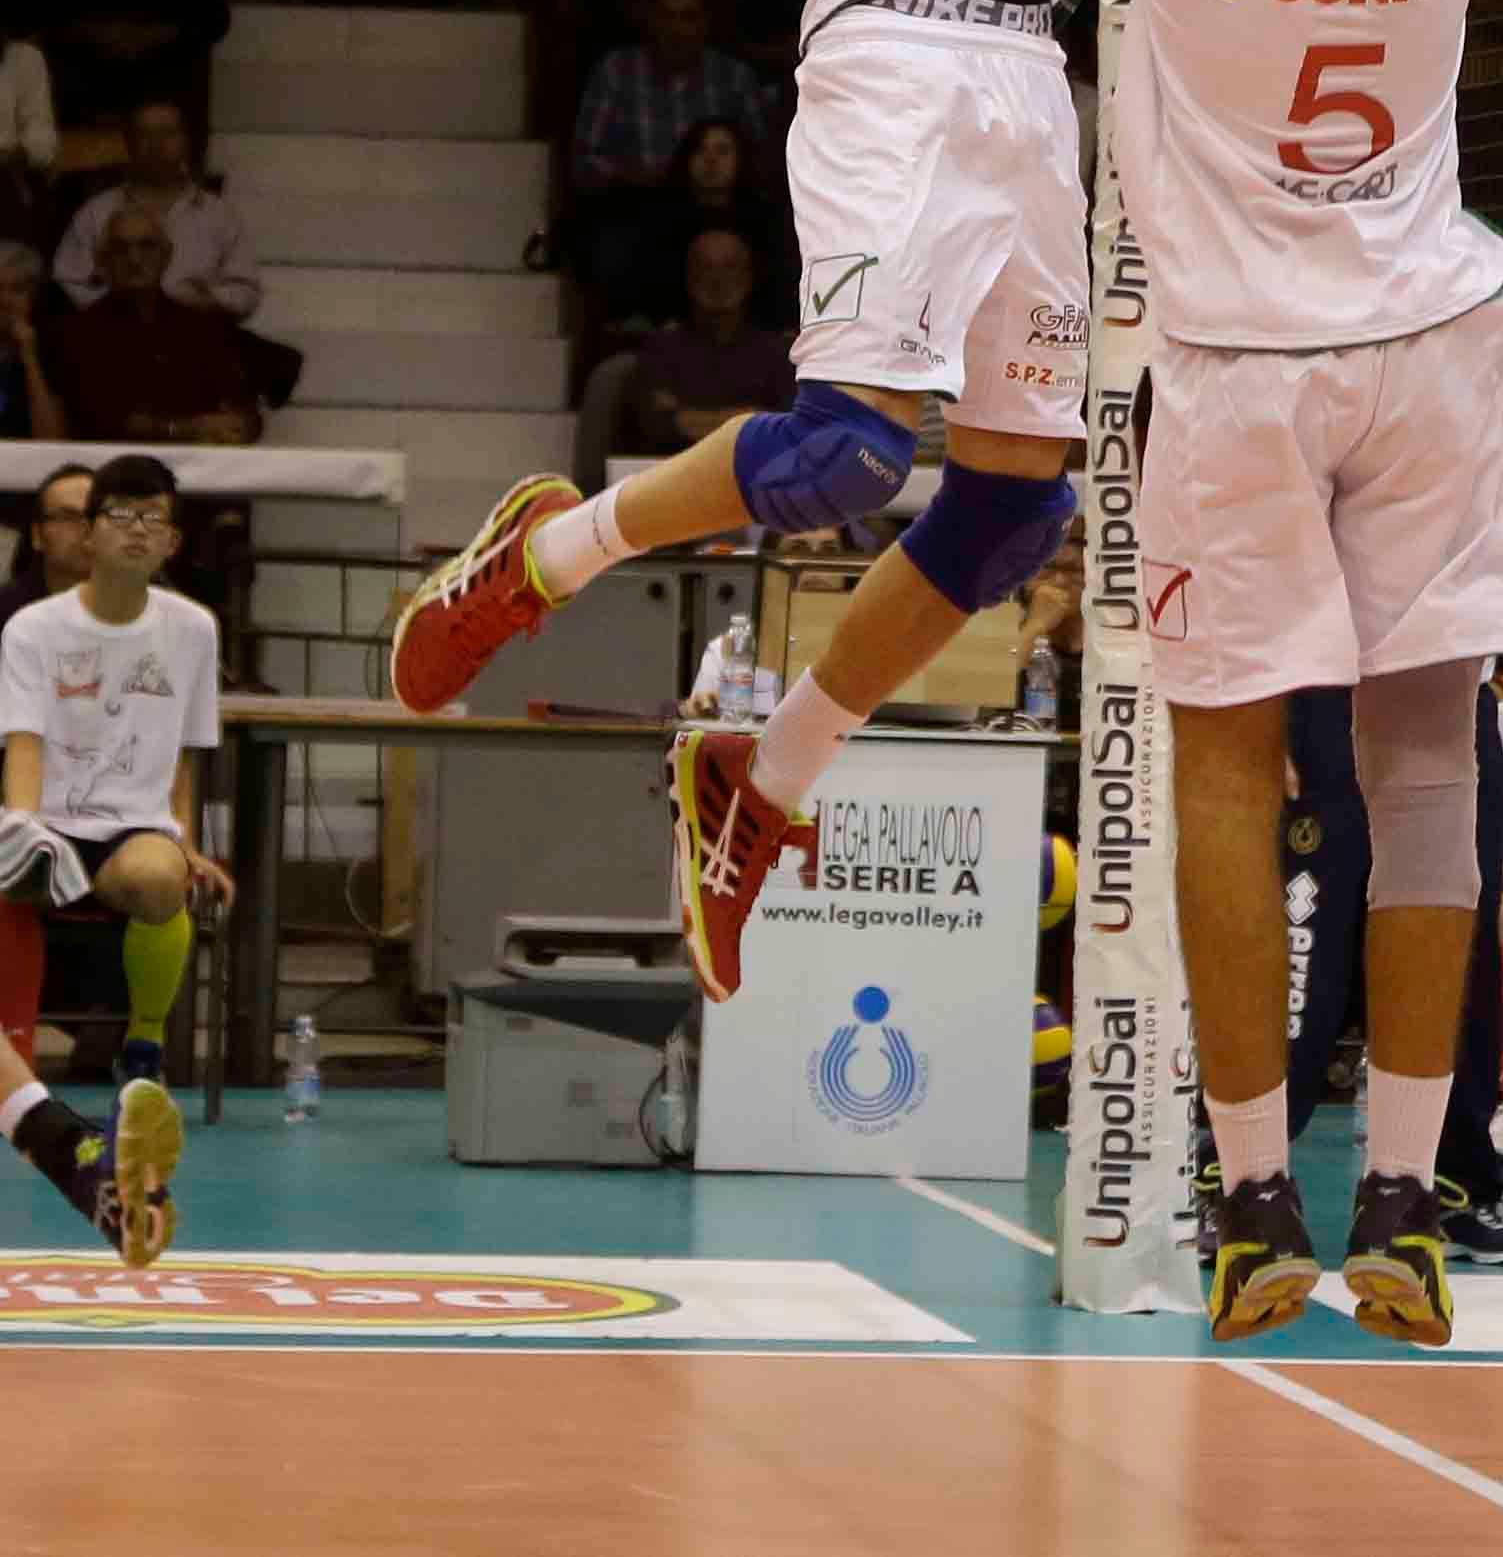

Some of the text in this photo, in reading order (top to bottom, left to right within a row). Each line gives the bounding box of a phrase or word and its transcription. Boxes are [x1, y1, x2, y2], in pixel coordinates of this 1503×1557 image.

[1277, 42, 1396, 175] 5
[1092, 389, 1139, 631] UnipolSai
[1090, 682, 1151, 934] UnipolSai
[1140, 685, 1155, 830] ASSICURAZIONI
[822, 801, 984, 868] LEGA PALLAVOLO
[823, 864, 982, 897] SERIE A
[761, 903, 984, 934] www.legavolley.it
[1082, 996, 1151, 1248] UnipolSai
[1141, 995, 1157, 1144] ASSICURAZIONI
